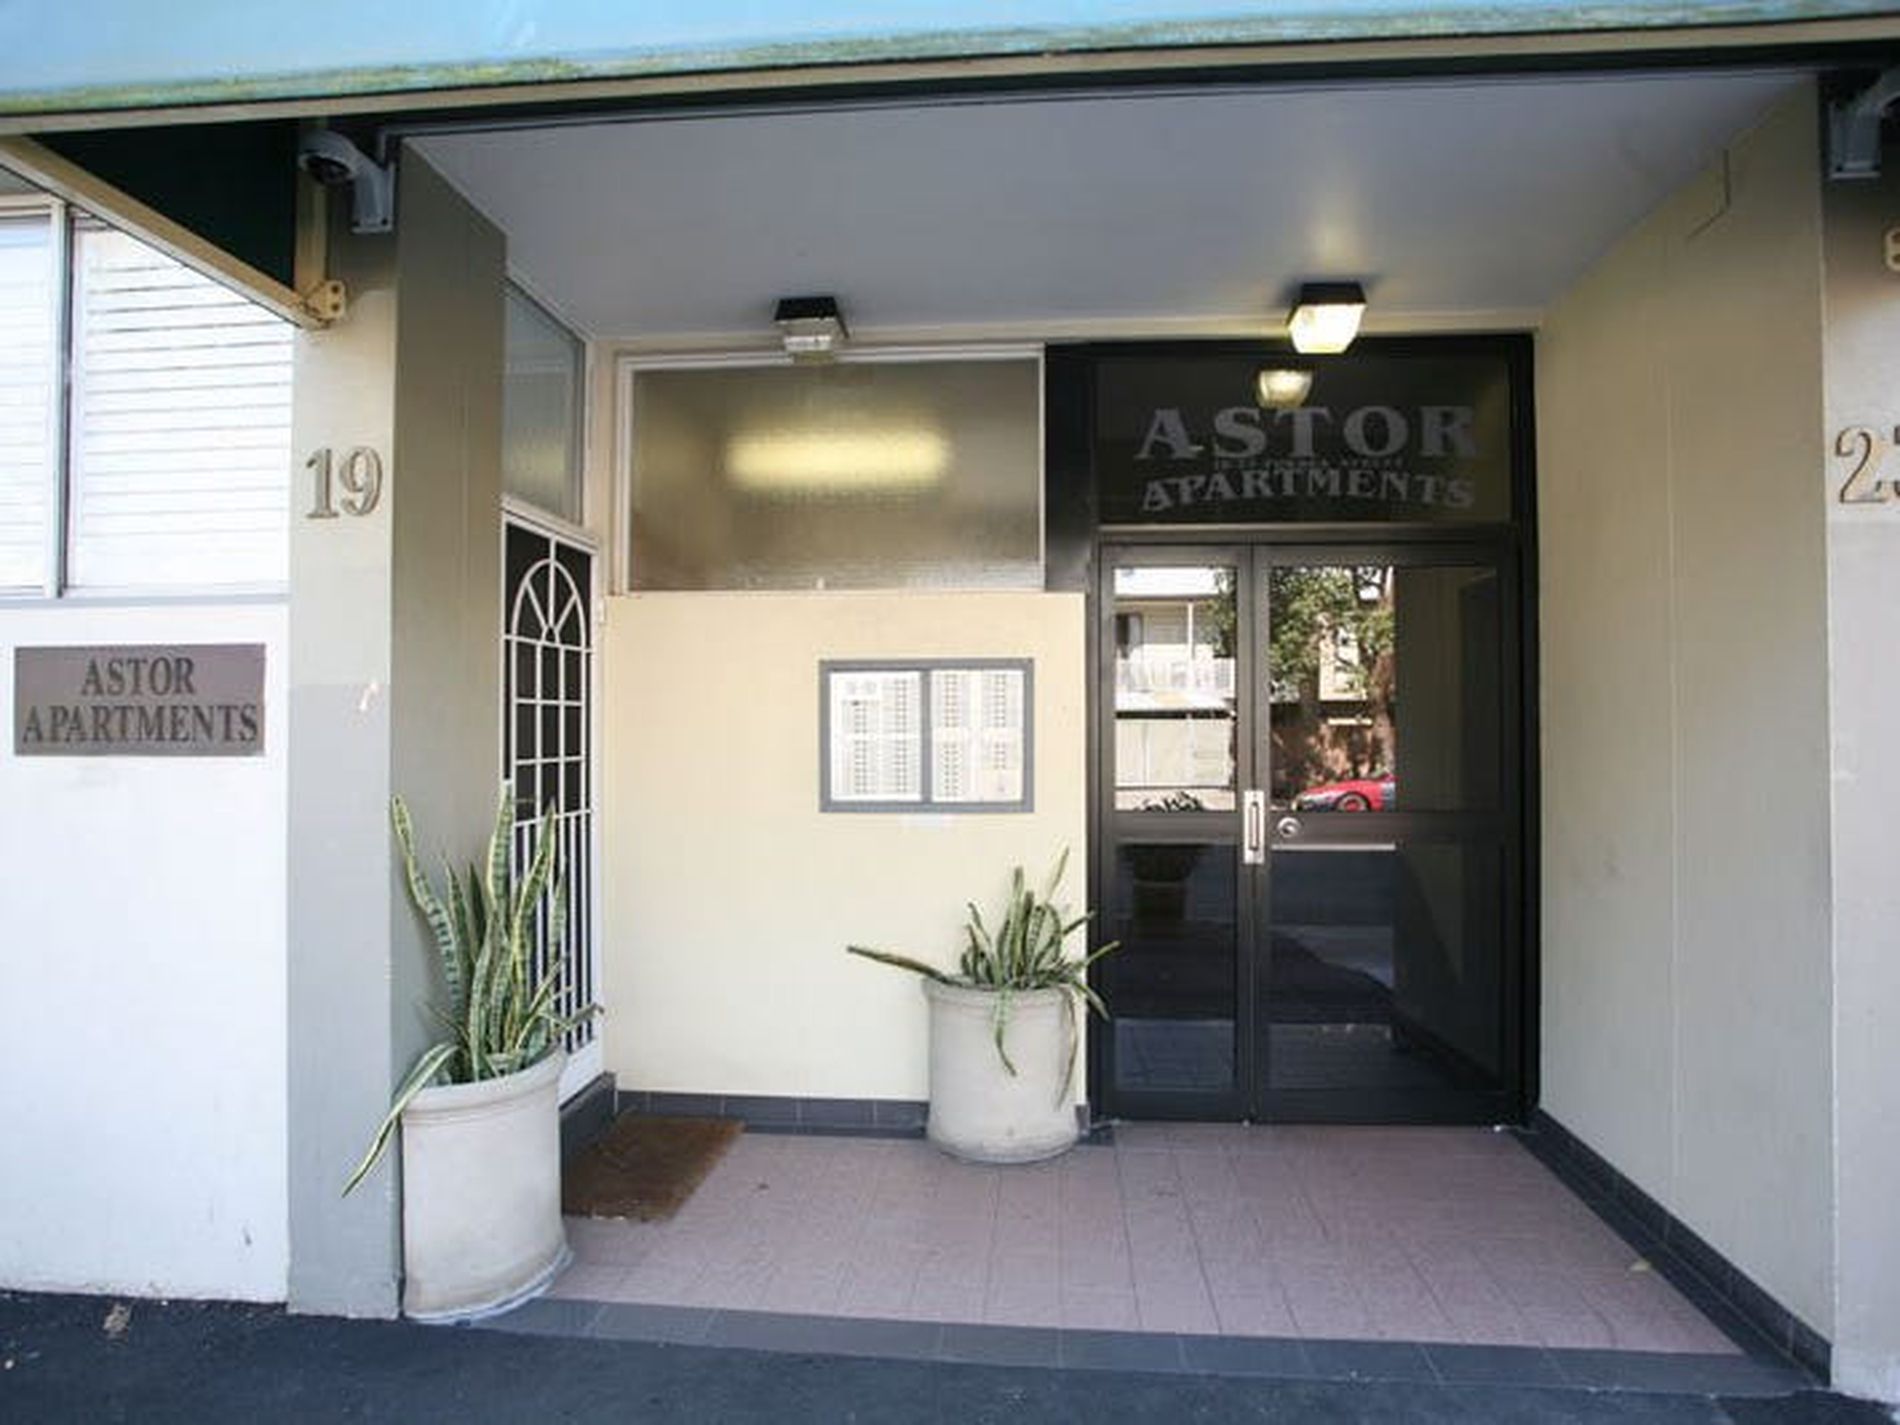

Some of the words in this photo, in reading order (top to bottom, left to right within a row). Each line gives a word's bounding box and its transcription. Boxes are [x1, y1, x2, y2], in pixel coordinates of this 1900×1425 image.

[1133, 404, 1478, 459] ASTOR
[305, 446, 383, 519] 19
[1835, 424, 1900, 504] 2
[1143, 468, 1476, 512] APARTMENTS
[81, 656, 196, 697] ASTOR
[22, 703, 259, 743] APARTMENTS
